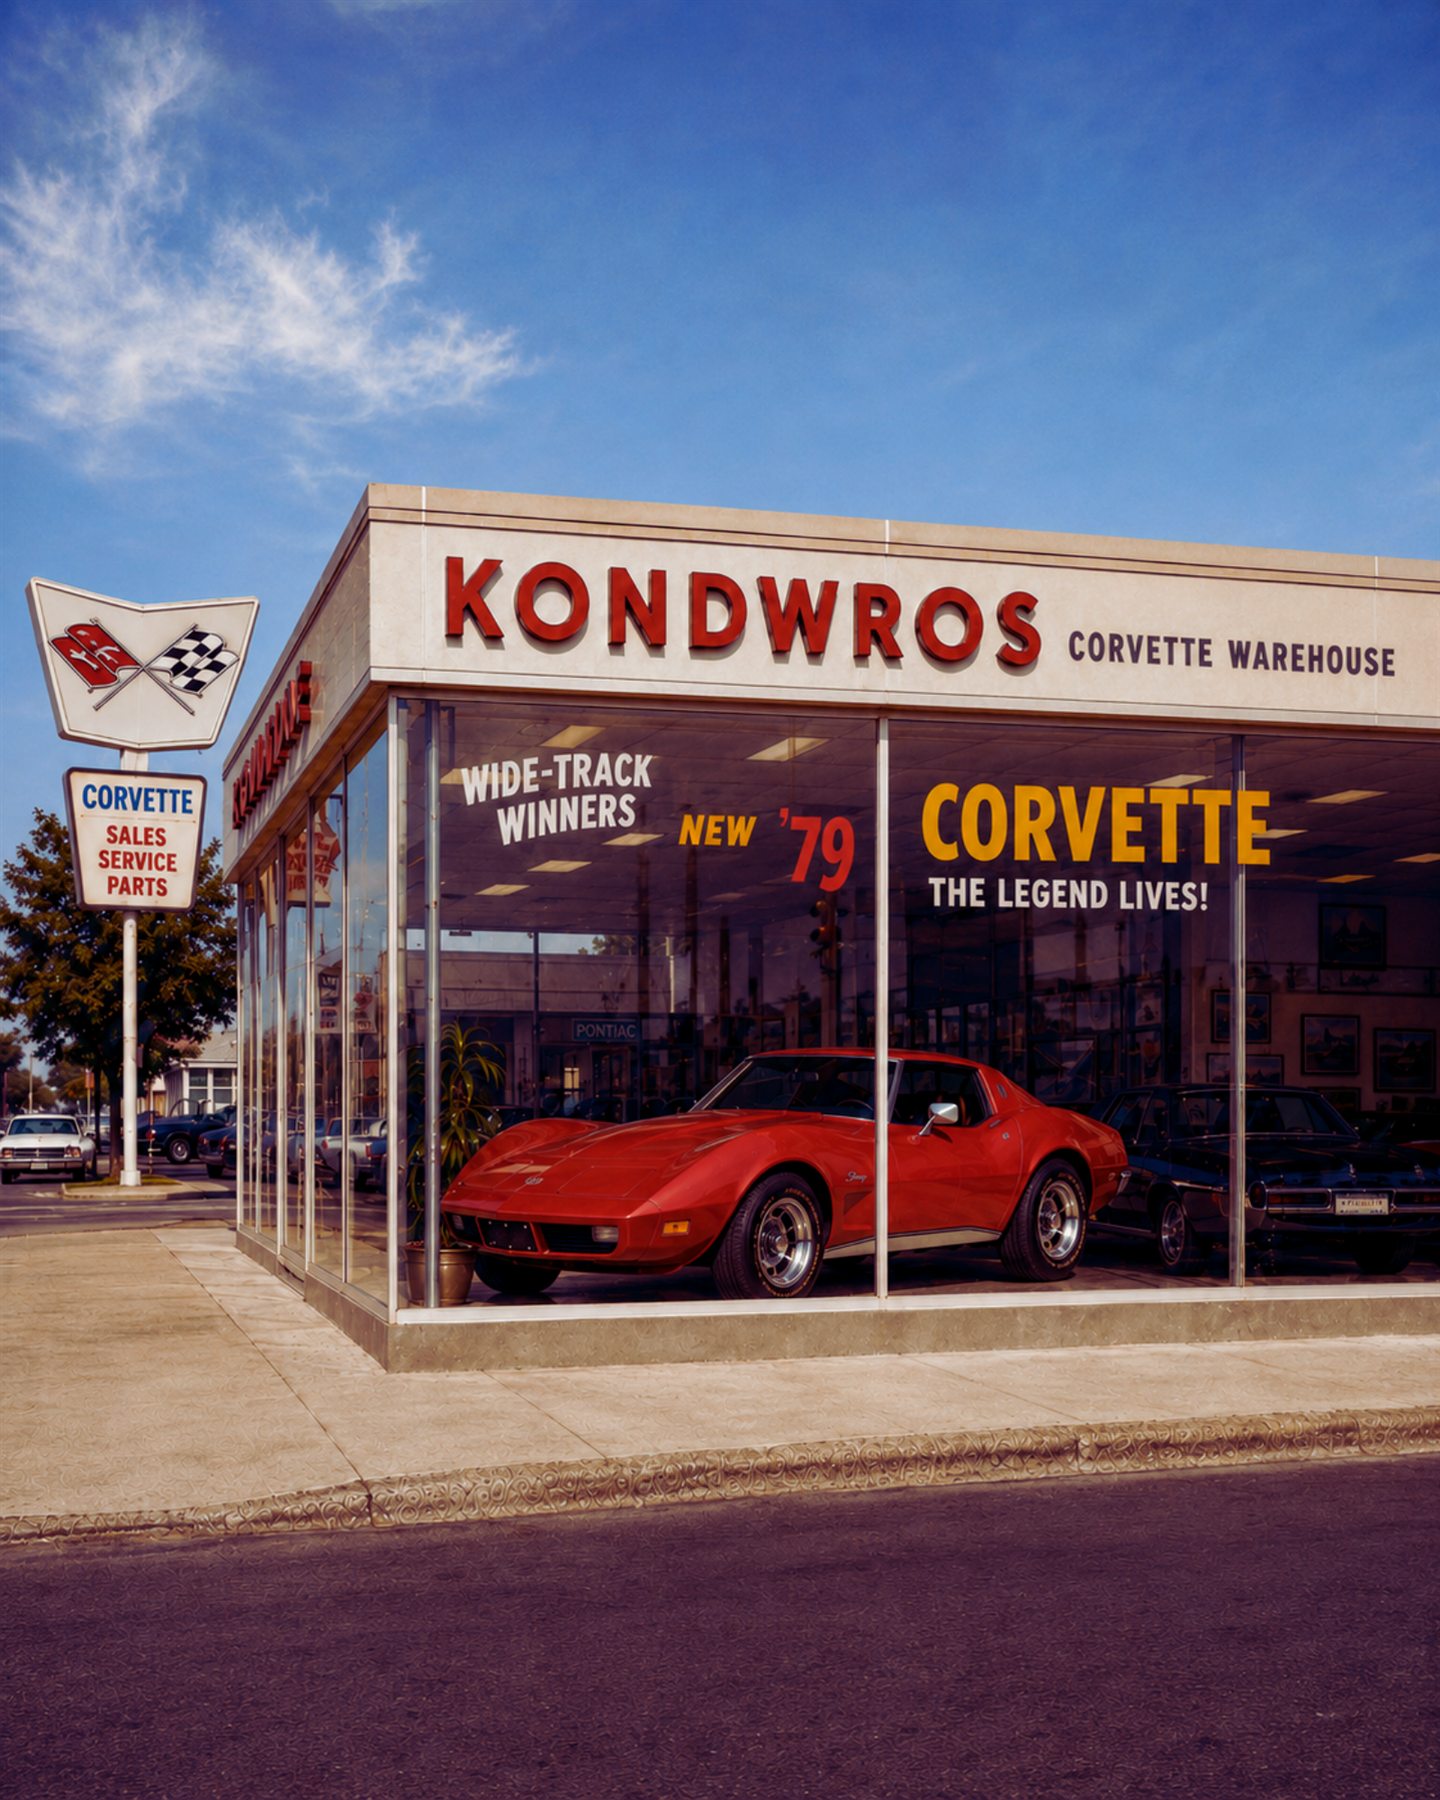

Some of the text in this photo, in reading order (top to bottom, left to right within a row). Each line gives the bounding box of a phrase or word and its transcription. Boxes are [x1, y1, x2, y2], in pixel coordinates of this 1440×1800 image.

[445, 556, 1042, 666] KONDWROS
[1069, 631, 1395, 677] CORVETTE WAREHOUSE
[82, 784, 193, 814] CORVETTE
[461, 753, 652, 806] WIDE-TRACK
[106, 825, 167, 847] SALES
[497, 793, 636, 846] WINNERS
[921, 782, 1271, 865] CORVETTE
[98, 850, 177, 873] SERVICE
[678, 807, 855, 893] NEW '79
[107, 876, 168, 897] PARTS
[928, 877, 1208, 911] THE LEGEND LIVES!
[576, 1023, 637, 1039] PONTIAC
